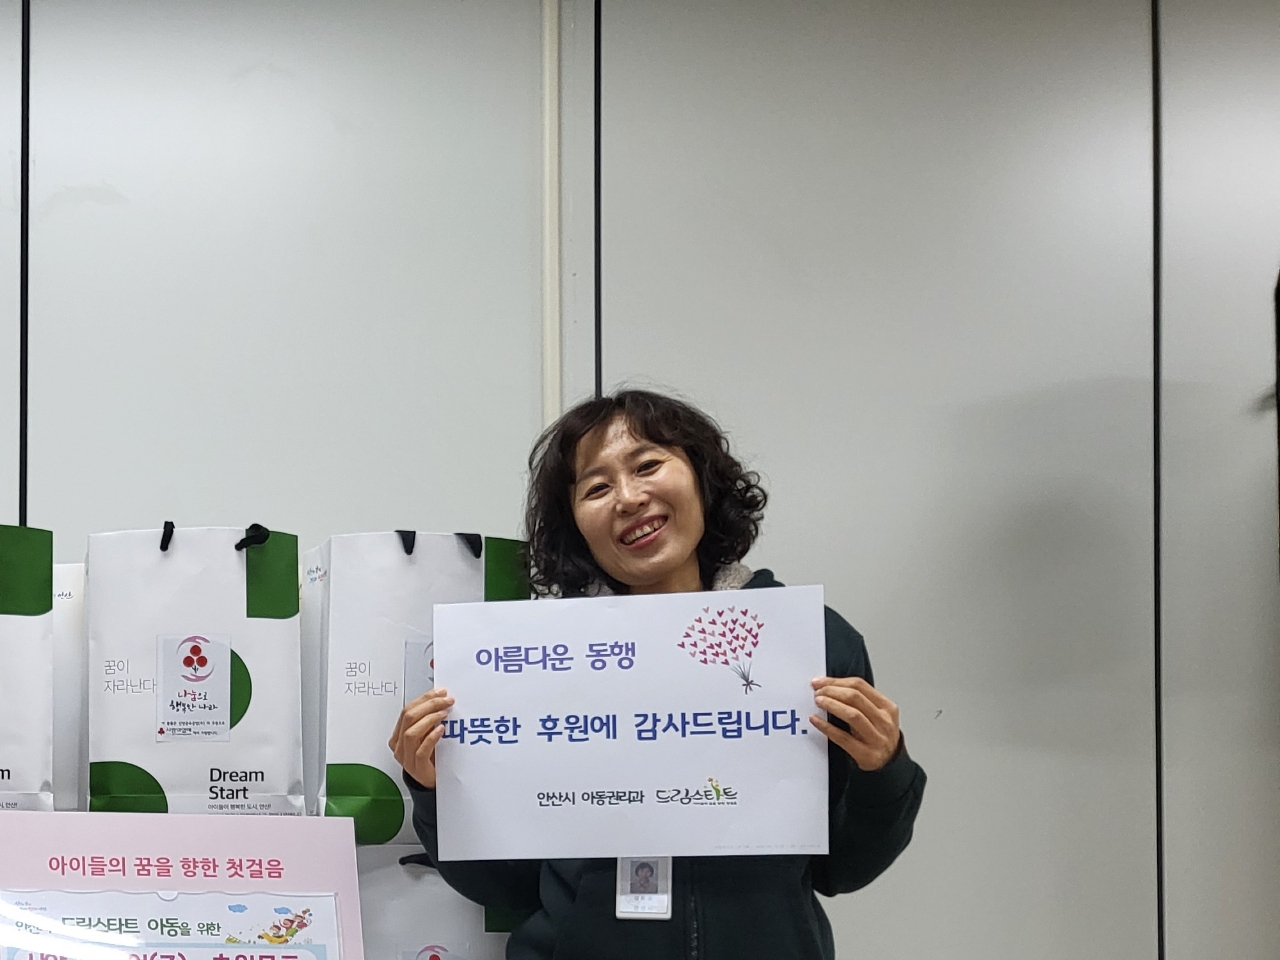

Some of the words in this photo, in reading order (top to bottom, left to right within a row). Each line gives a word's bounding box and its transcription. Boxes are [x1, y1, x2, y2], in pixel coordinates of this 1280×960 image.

[476, 644, 574, 673] 아름다운
[585, 641, 636, 670] 동행
[104, 659, 129, 675] 꿈이
[345, 660, 371, 677] 꿈이
[104, 678, 157, 694] 자라난다
[344, 681, 399, 696] 자라난다
[441, 716, 521, 745] 따뜻한
[537, 713, 618, 743] 후원에
[634, 709, 808, 740] 감사드립니다.
[209, 768, 265, 782] Dream
[208, 785, 249, 800] Start
[537, 791, 575, 806] 안산시
[581, 790, 645, 806] 아동권리과
[49, 855, 126, 877] 아이들의
[134, 857, 173, 877] 꿈을
[180, 857, 219, 878] 향한
[226, 858, 285, 879] 첫걸음
[147, 917, 191, 937] 아동을
[197, 921, 222, 936] 위한
